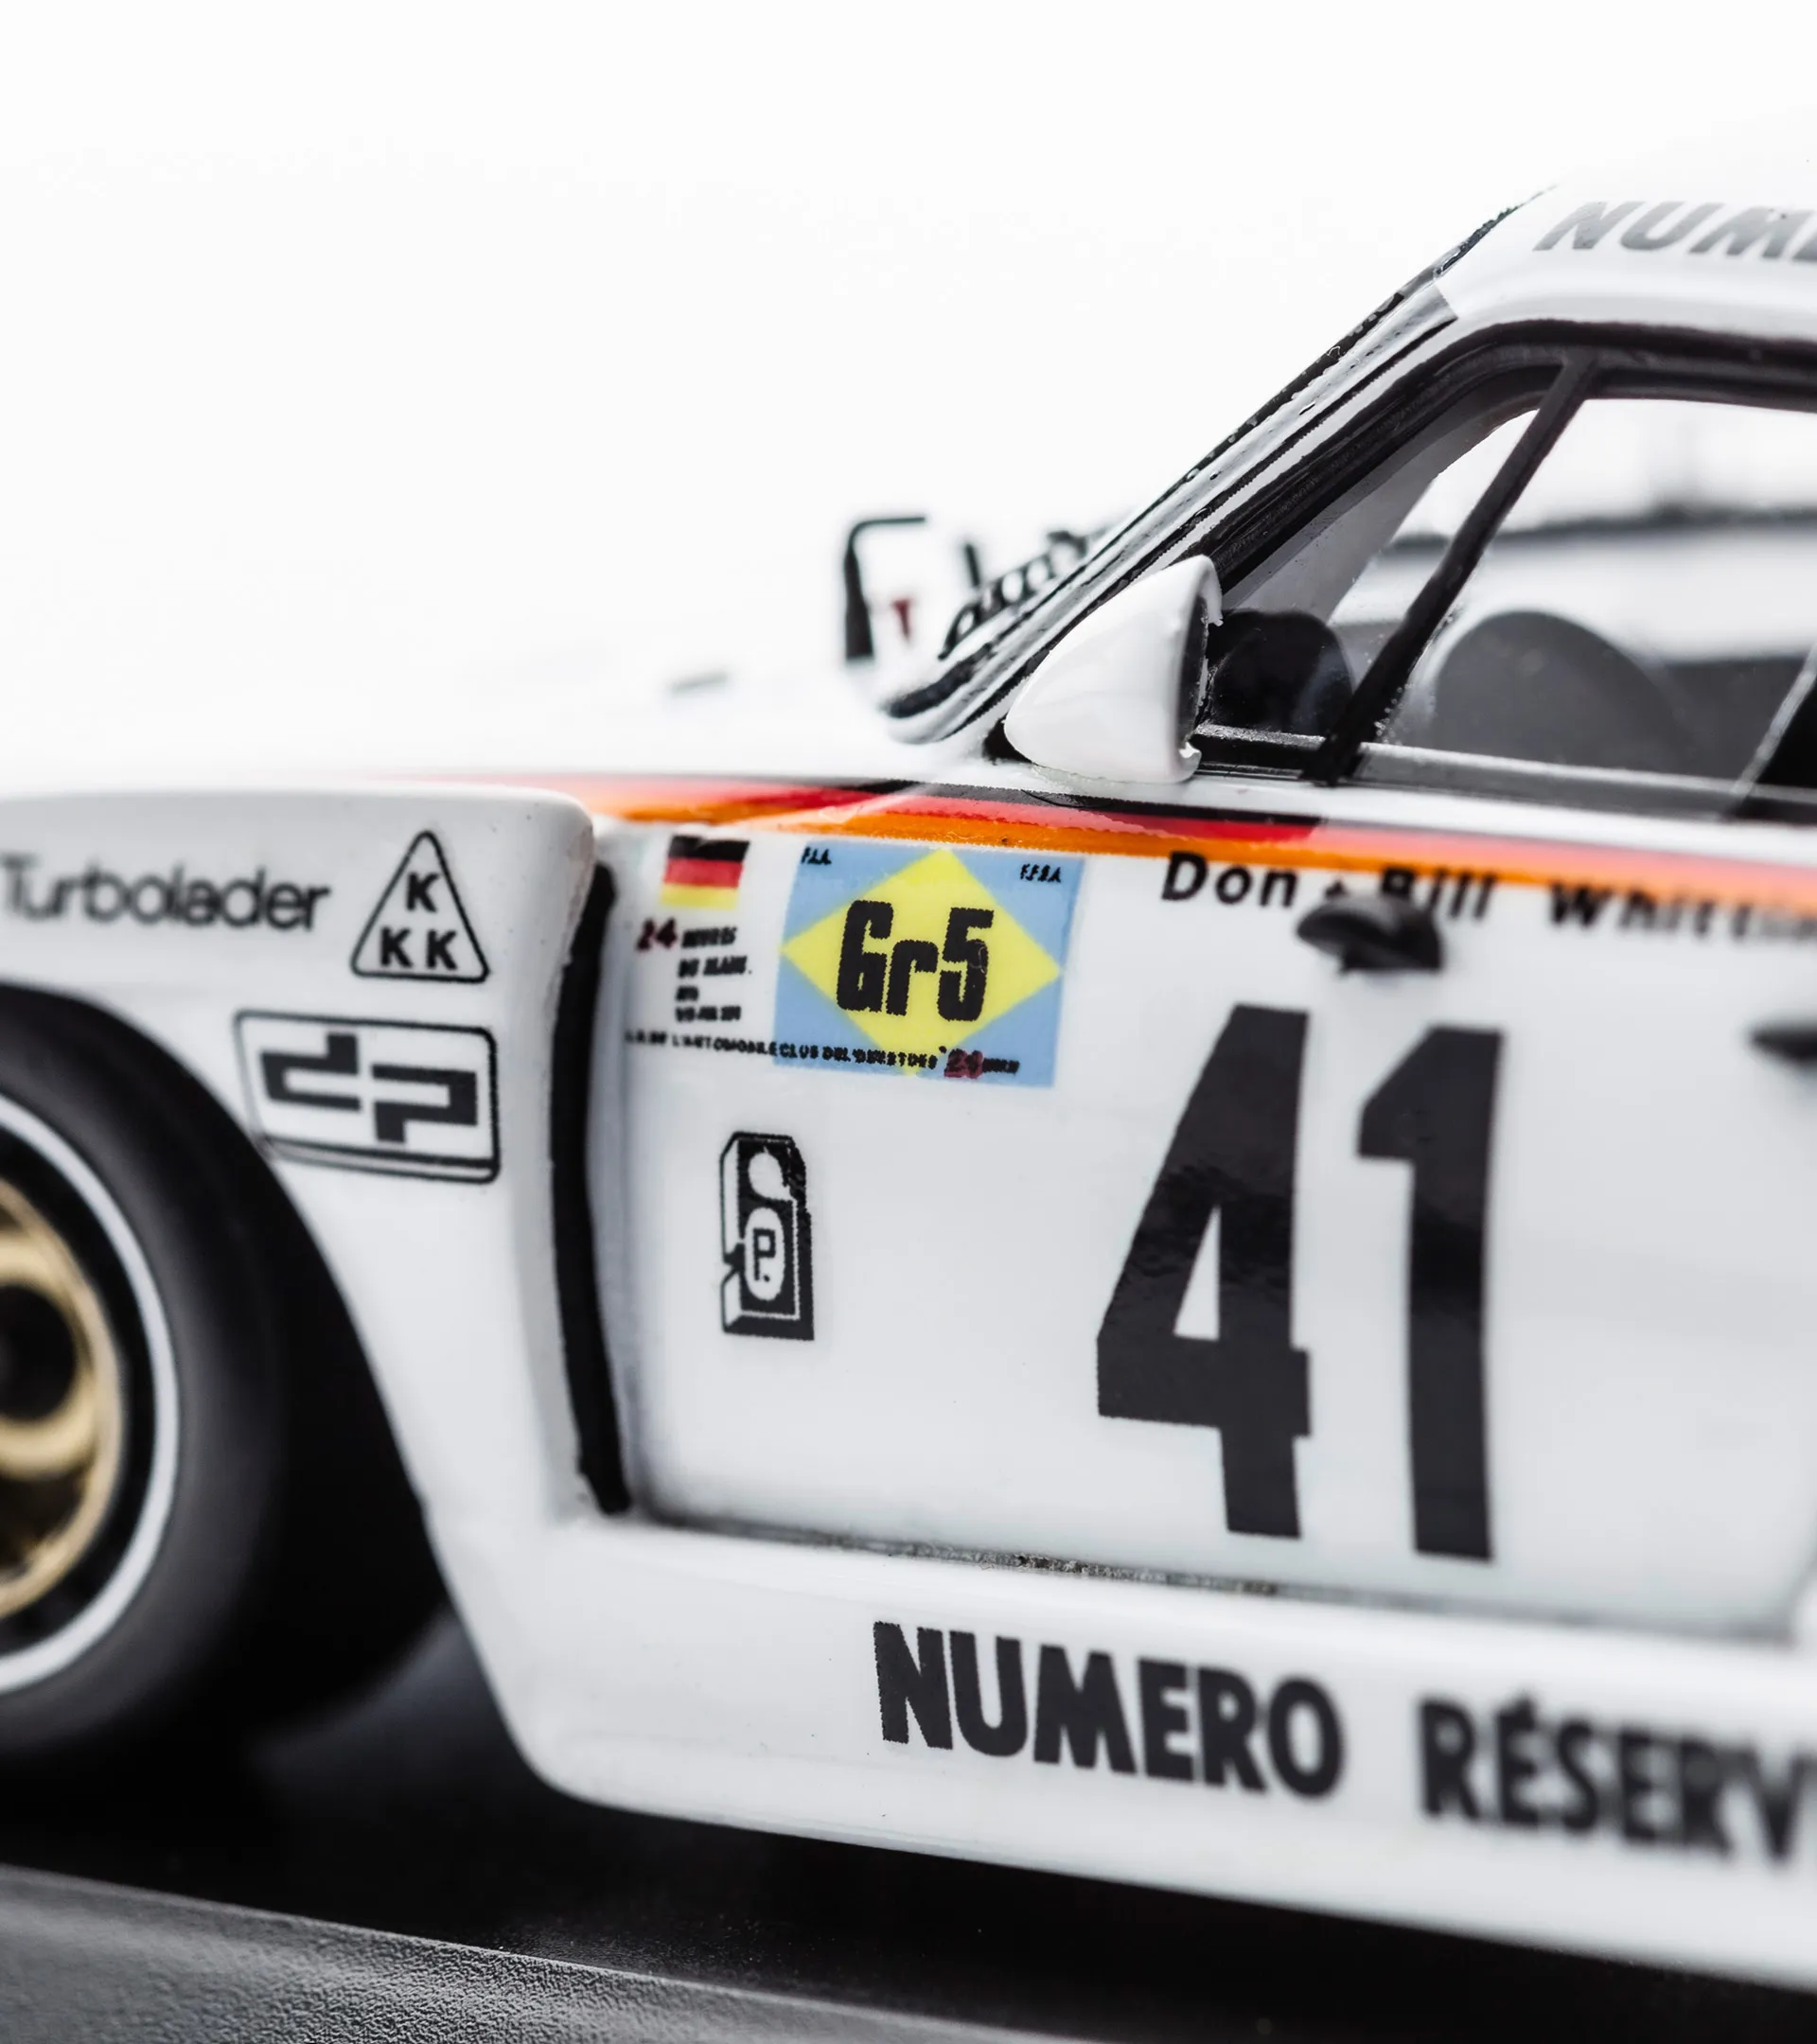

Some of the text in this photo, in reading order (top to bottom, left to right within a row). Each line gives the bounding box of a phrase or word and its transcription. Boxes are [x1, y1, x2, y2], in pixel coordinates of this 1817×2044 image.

[0, 852, 330, 931] Turbolader
[1162, 850, 1297, 907] Don
[837, 900, 995, 1021] Gr5
[1097, 1004, 1503, 1563] 41
[873, 1621, 1345, 1797] NUMERO
